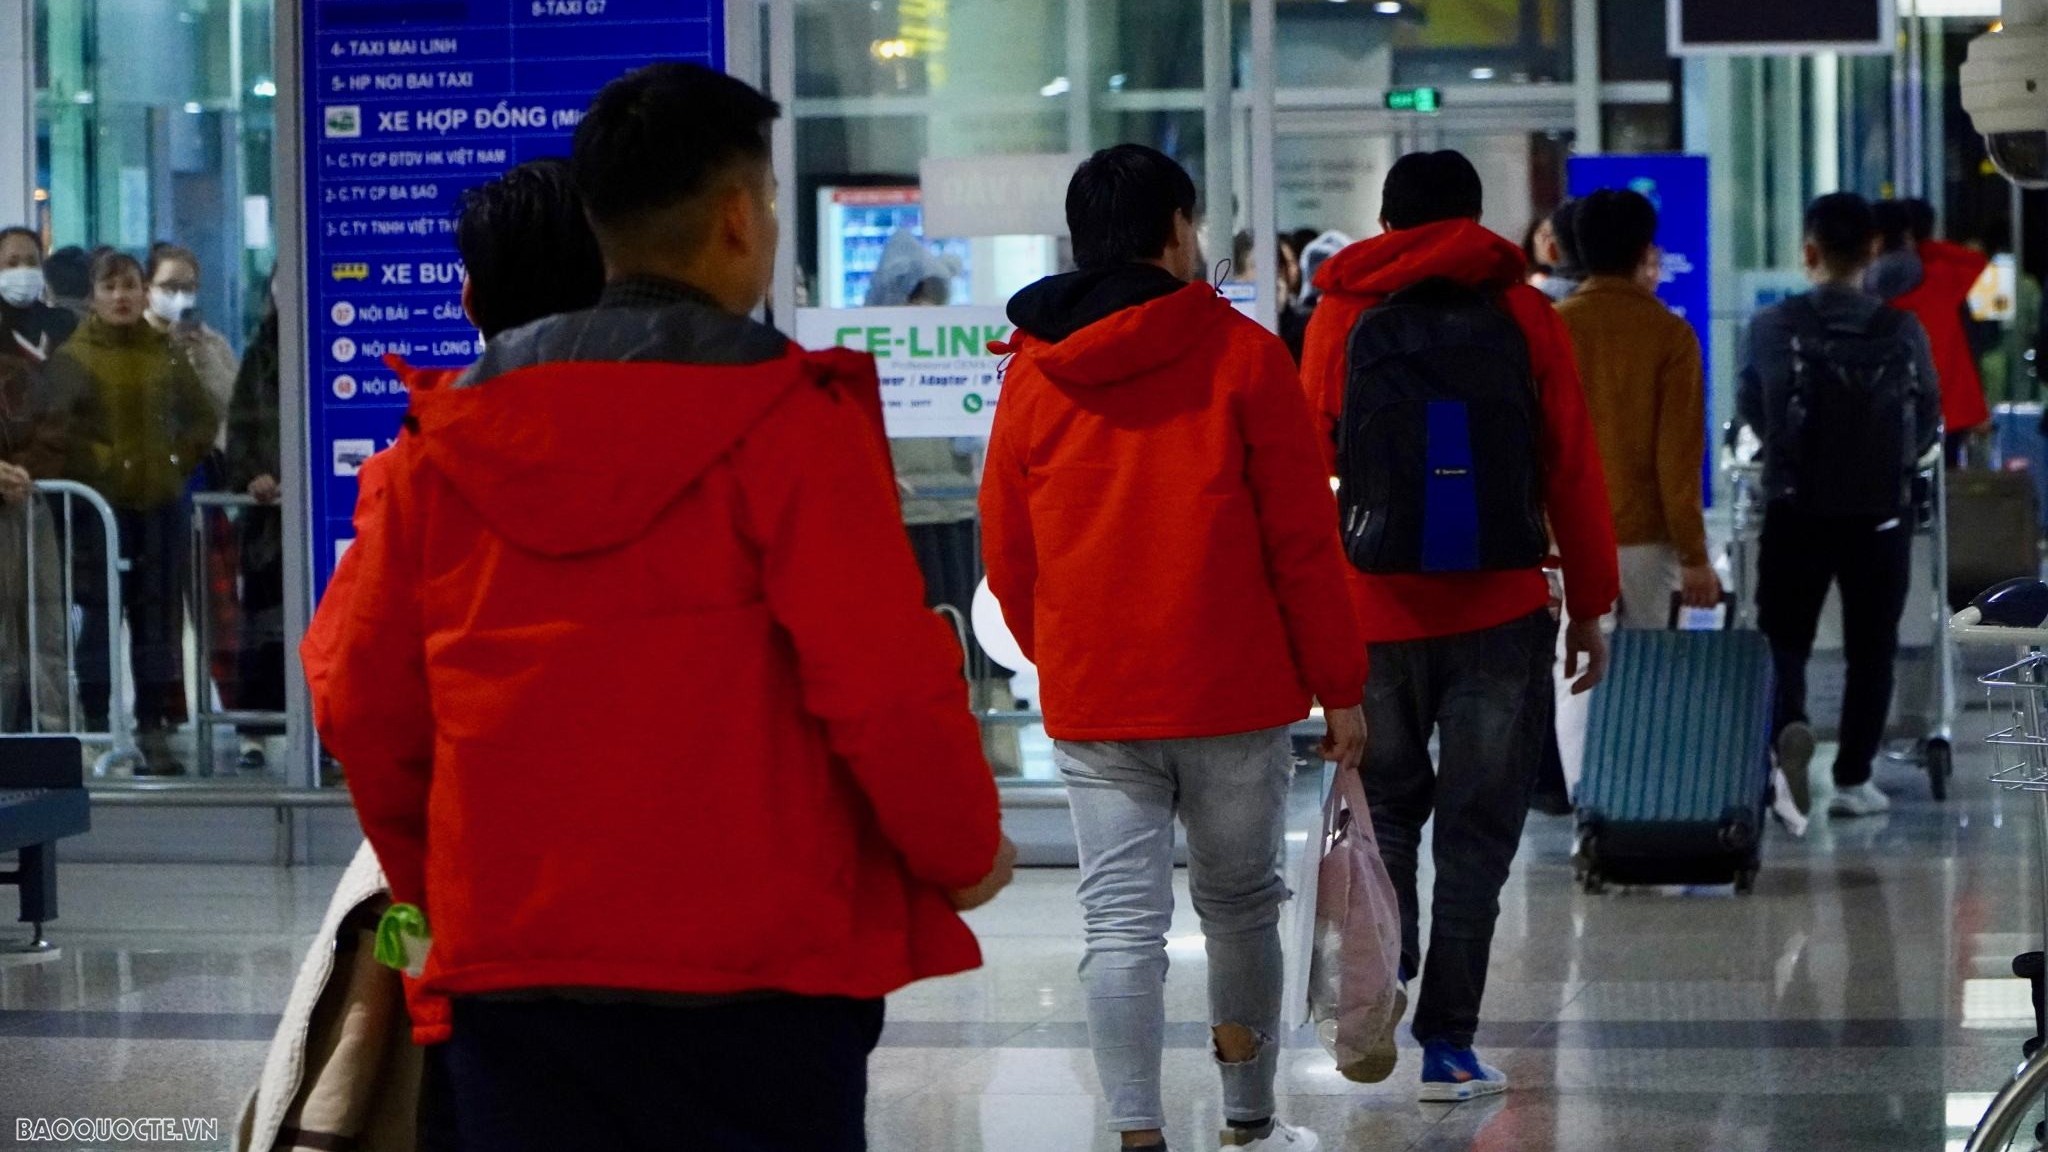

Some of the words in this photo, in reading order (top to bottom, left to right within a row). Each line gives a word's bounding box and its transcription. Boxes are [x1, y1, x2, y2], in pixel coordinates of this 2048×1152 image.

[349, 40, 385, 56] TAXI
[388, 39, 417, 55] MAI
[420, 38, 457, 55] LINH
[349, 74, 372, 90] HP
[437, 71, 473, 88] TAXI
[378, 111, 410, 132] XE
[416, 107, 468, 136] HỢP
[474, 99, 547, 129] ĐỒNG
[369, 152, 387, 168] CP
[446, 147, 474, 166] VIỆT
[476, 149, 506, 164] NAM
[369, 186, 387, 201] CP
[389, 185, 408, 200] BA
[410, 184, 438, 199] SAO
[407, 217, 434, 236] VIỆT
[381, 263, 412, 285] XE
[432, 339, 471, 356] LONG
[919, 374, 967, 388] Adapter
